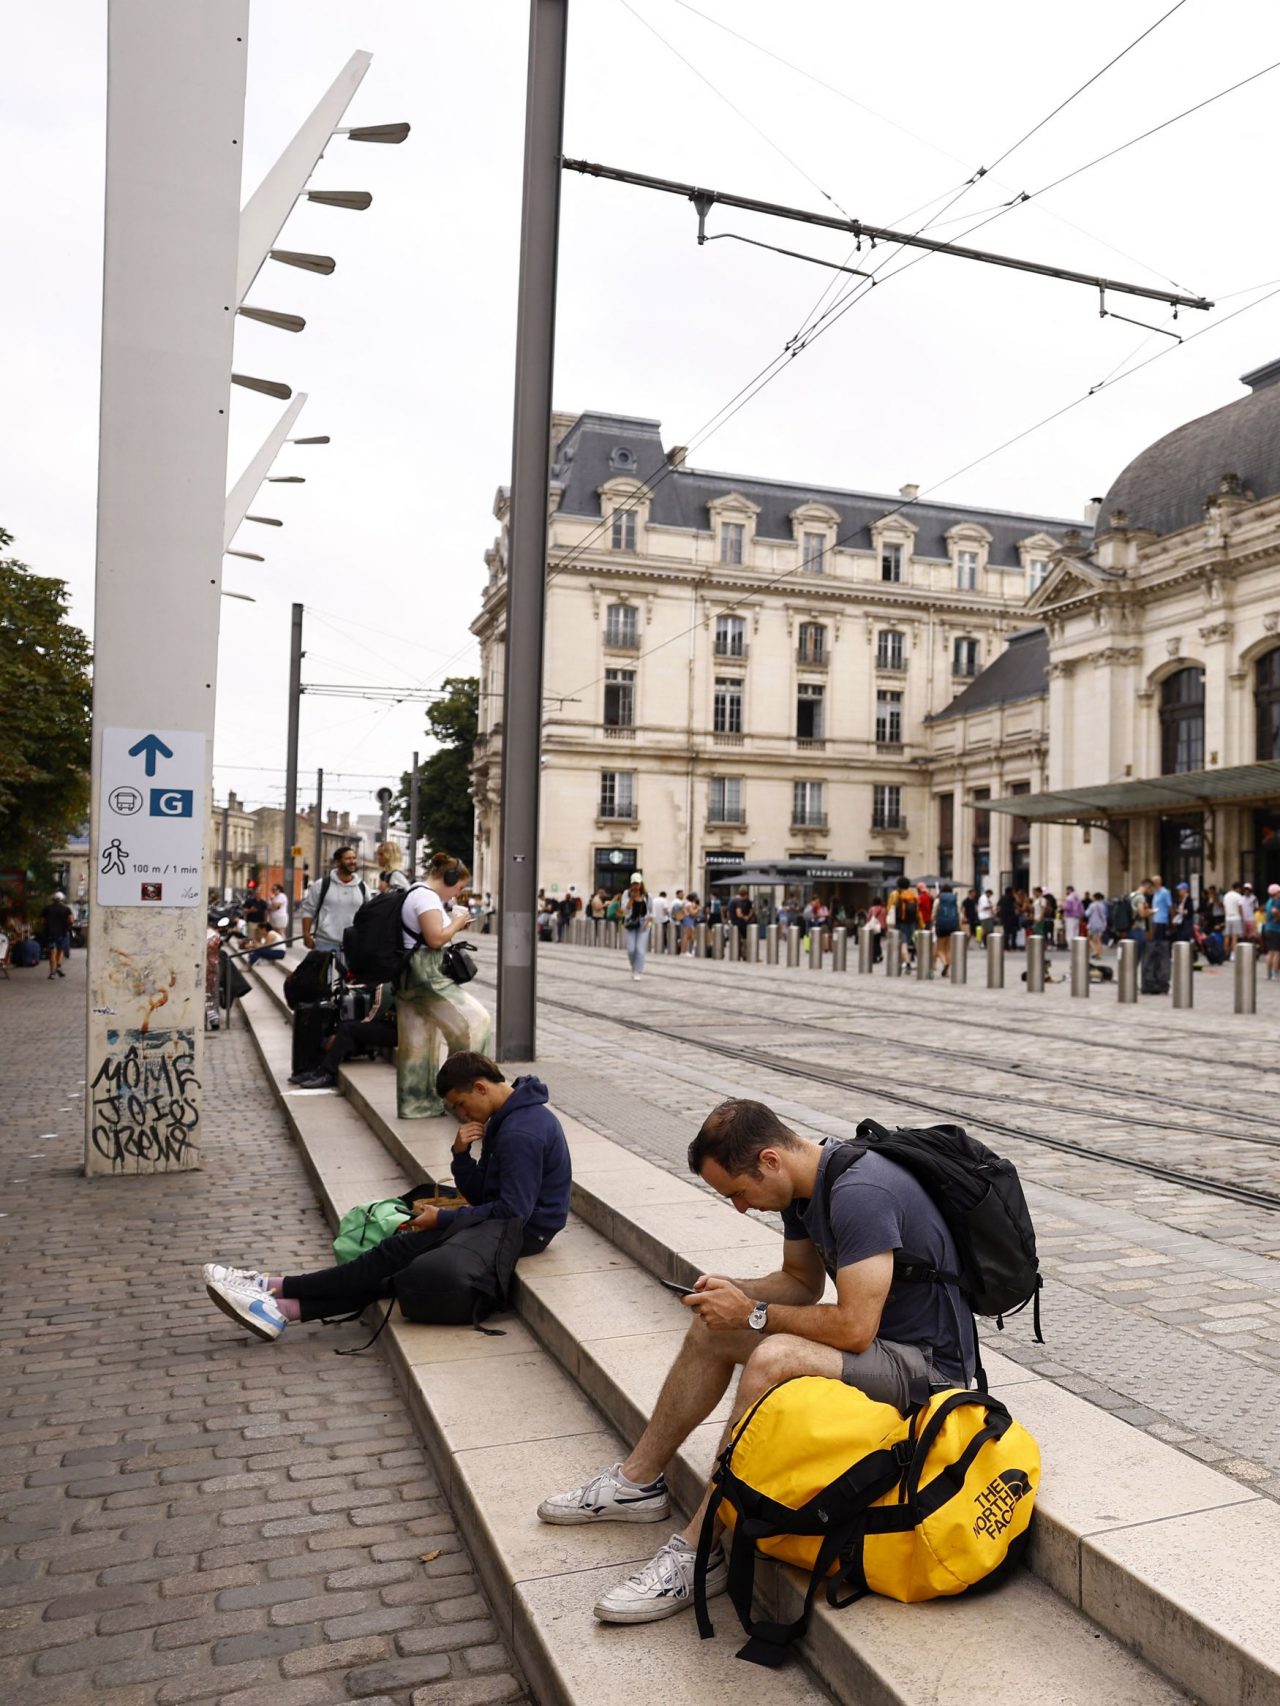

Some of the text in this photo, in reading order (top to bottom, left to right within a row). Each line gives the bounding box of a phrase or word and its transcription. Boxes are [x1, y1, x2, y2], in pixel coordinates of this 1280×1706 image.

[159, 792, 183, 815] G
[133, 864, 149, 873] 100
[180, 865, 198, 874] min
[806, 869, 854, 878] STARBUCKS
[974, 1478, 1006, 1510] THE
[972, 1488, 1014, 1541] NORTH
[985, 1500, 1016, 1540] FACE
